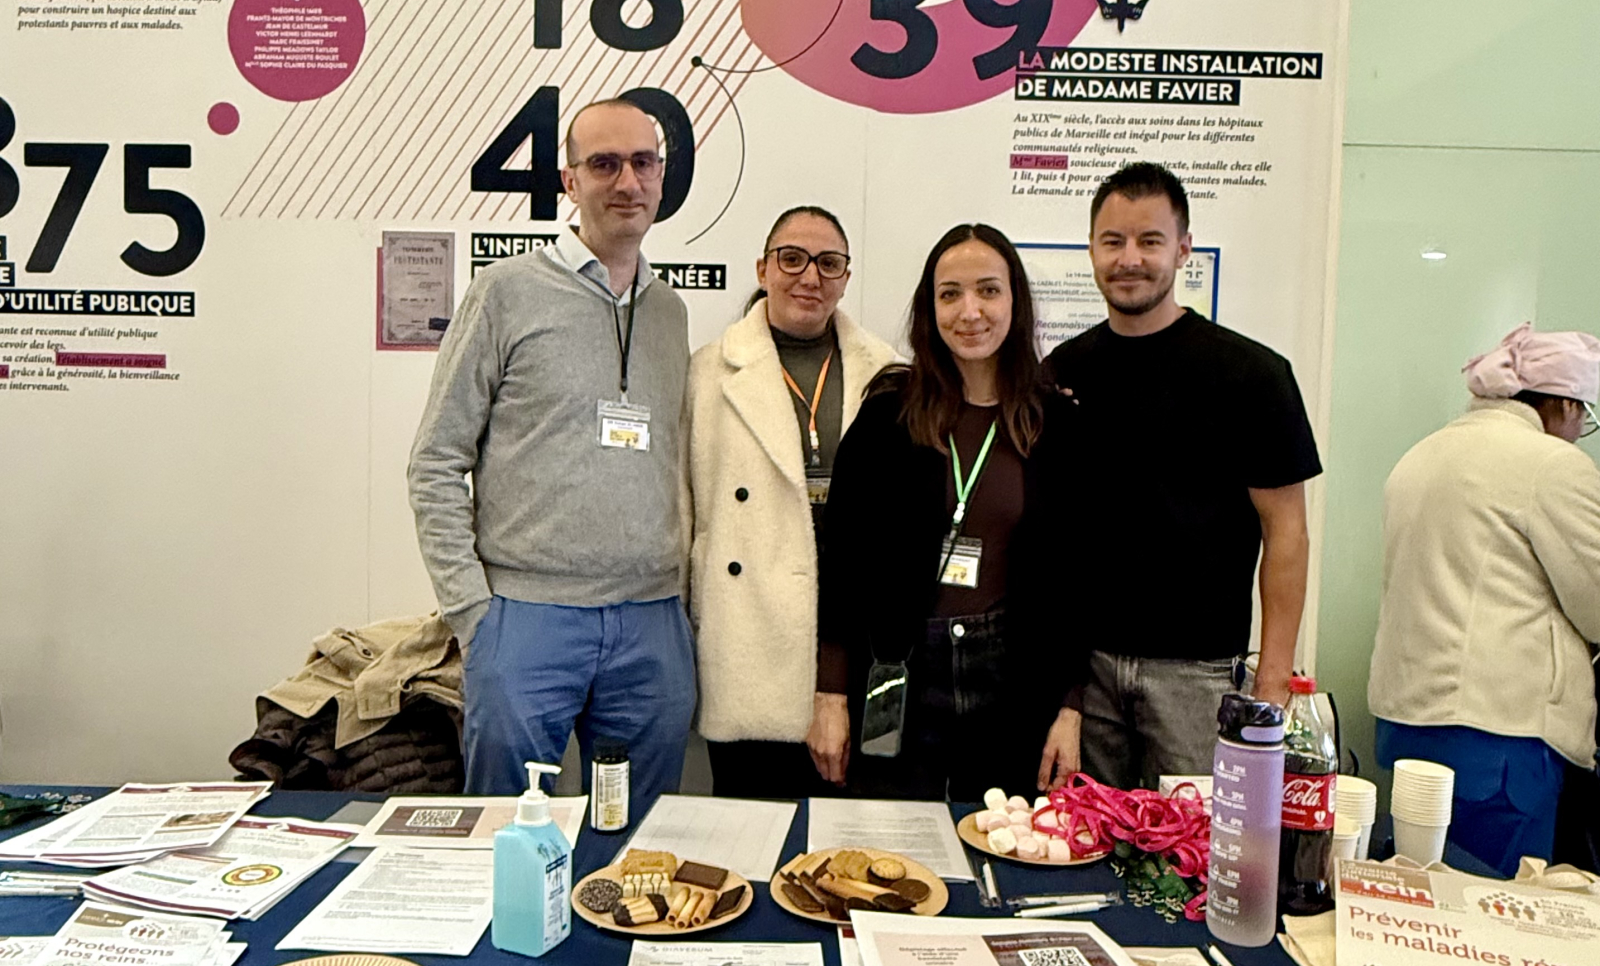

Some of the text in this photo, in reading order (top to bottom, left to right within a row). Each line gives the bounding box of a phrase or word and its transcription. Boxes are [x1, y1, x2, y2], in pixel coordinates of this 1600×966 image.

[17, 4, 196, 16] pour construire un hospice destiné aux
[17, 20, 69, 30] protestants
[71, 21, 107, 30] pauvres
[141, 20, 183, 29] malades.
[1019, 51, 1317, 76] LA MODESTE INSTALLATION
[1018, 78, 1233, 101] DE MADAME FAVIER
[1014, 113, 1028, 123] Au
[1064, 114, 1093, 126] siècle,
[1095, 114, 1126, 125] l'accès
[1128, 117, 1147, 126] aux
[1149, 116, 1174, 126] soins
[1177, 116, 1201, 126] dans
[1203, 117, 1216, 126] les
[1218, 117, 1264, 129] hôpitaux
[1013, 128, 1255, 144] publics de Marseille est inégal pour les différentes
[1013, 144, 1138, 156] communautés religieuses.
[1070, 158, 1116, 168] soucieuse
[1192, 160, 1228, 171] installe
[1230, 161, 1252, 171] chez
[1255, 162, 1272, 172] elle
[1012, 171, 1018, 180] 1
[1020, 171, 1034, 182] lit,
[1036, 172, 1057, 183] puis
[1059, 173, 1066, 182] 4
[1067, 174, 1091, 184] pour
[1223, 176, 1267, 186] malades.
[0, 97, 206, 277] 75
[1011, 185, 1024, 194] La
[1027, 185, 1073, 196] demande
[1075, 188, 1084, 196] se
[668, 265, 710, 287] NÉE
[89, 294, 192, 316] PUBLIQUE
[21, 327, 33, 335] est
[35, 328, 77, 336] reconnue
[79, 327, 115, 337] d'utilité
[116, 328, 158, 341] publique
[30, 340, 44, 349] des
[47, 340, 66, 352] legs.
[14, 353, 55, 364] création,
[10, 367, 36, 379] grâce
[38, 367, 44, 377] à
[46, 367, 55, 377] la
[57, 368, 106, 380] générosité,
[108, 369, 117, 379] la
[120, 370, 180, 380] bienveillance
[9, 381, 70, 391] intervenants.
[1360, 878, 1433, 901] rein
[1349, 905, 1462, 939] Prévenir
[64, 937, 174, 958] Protégeons
[1350, 926, 1511, 966] les maladies
[56, 949, 93, 960] nos
